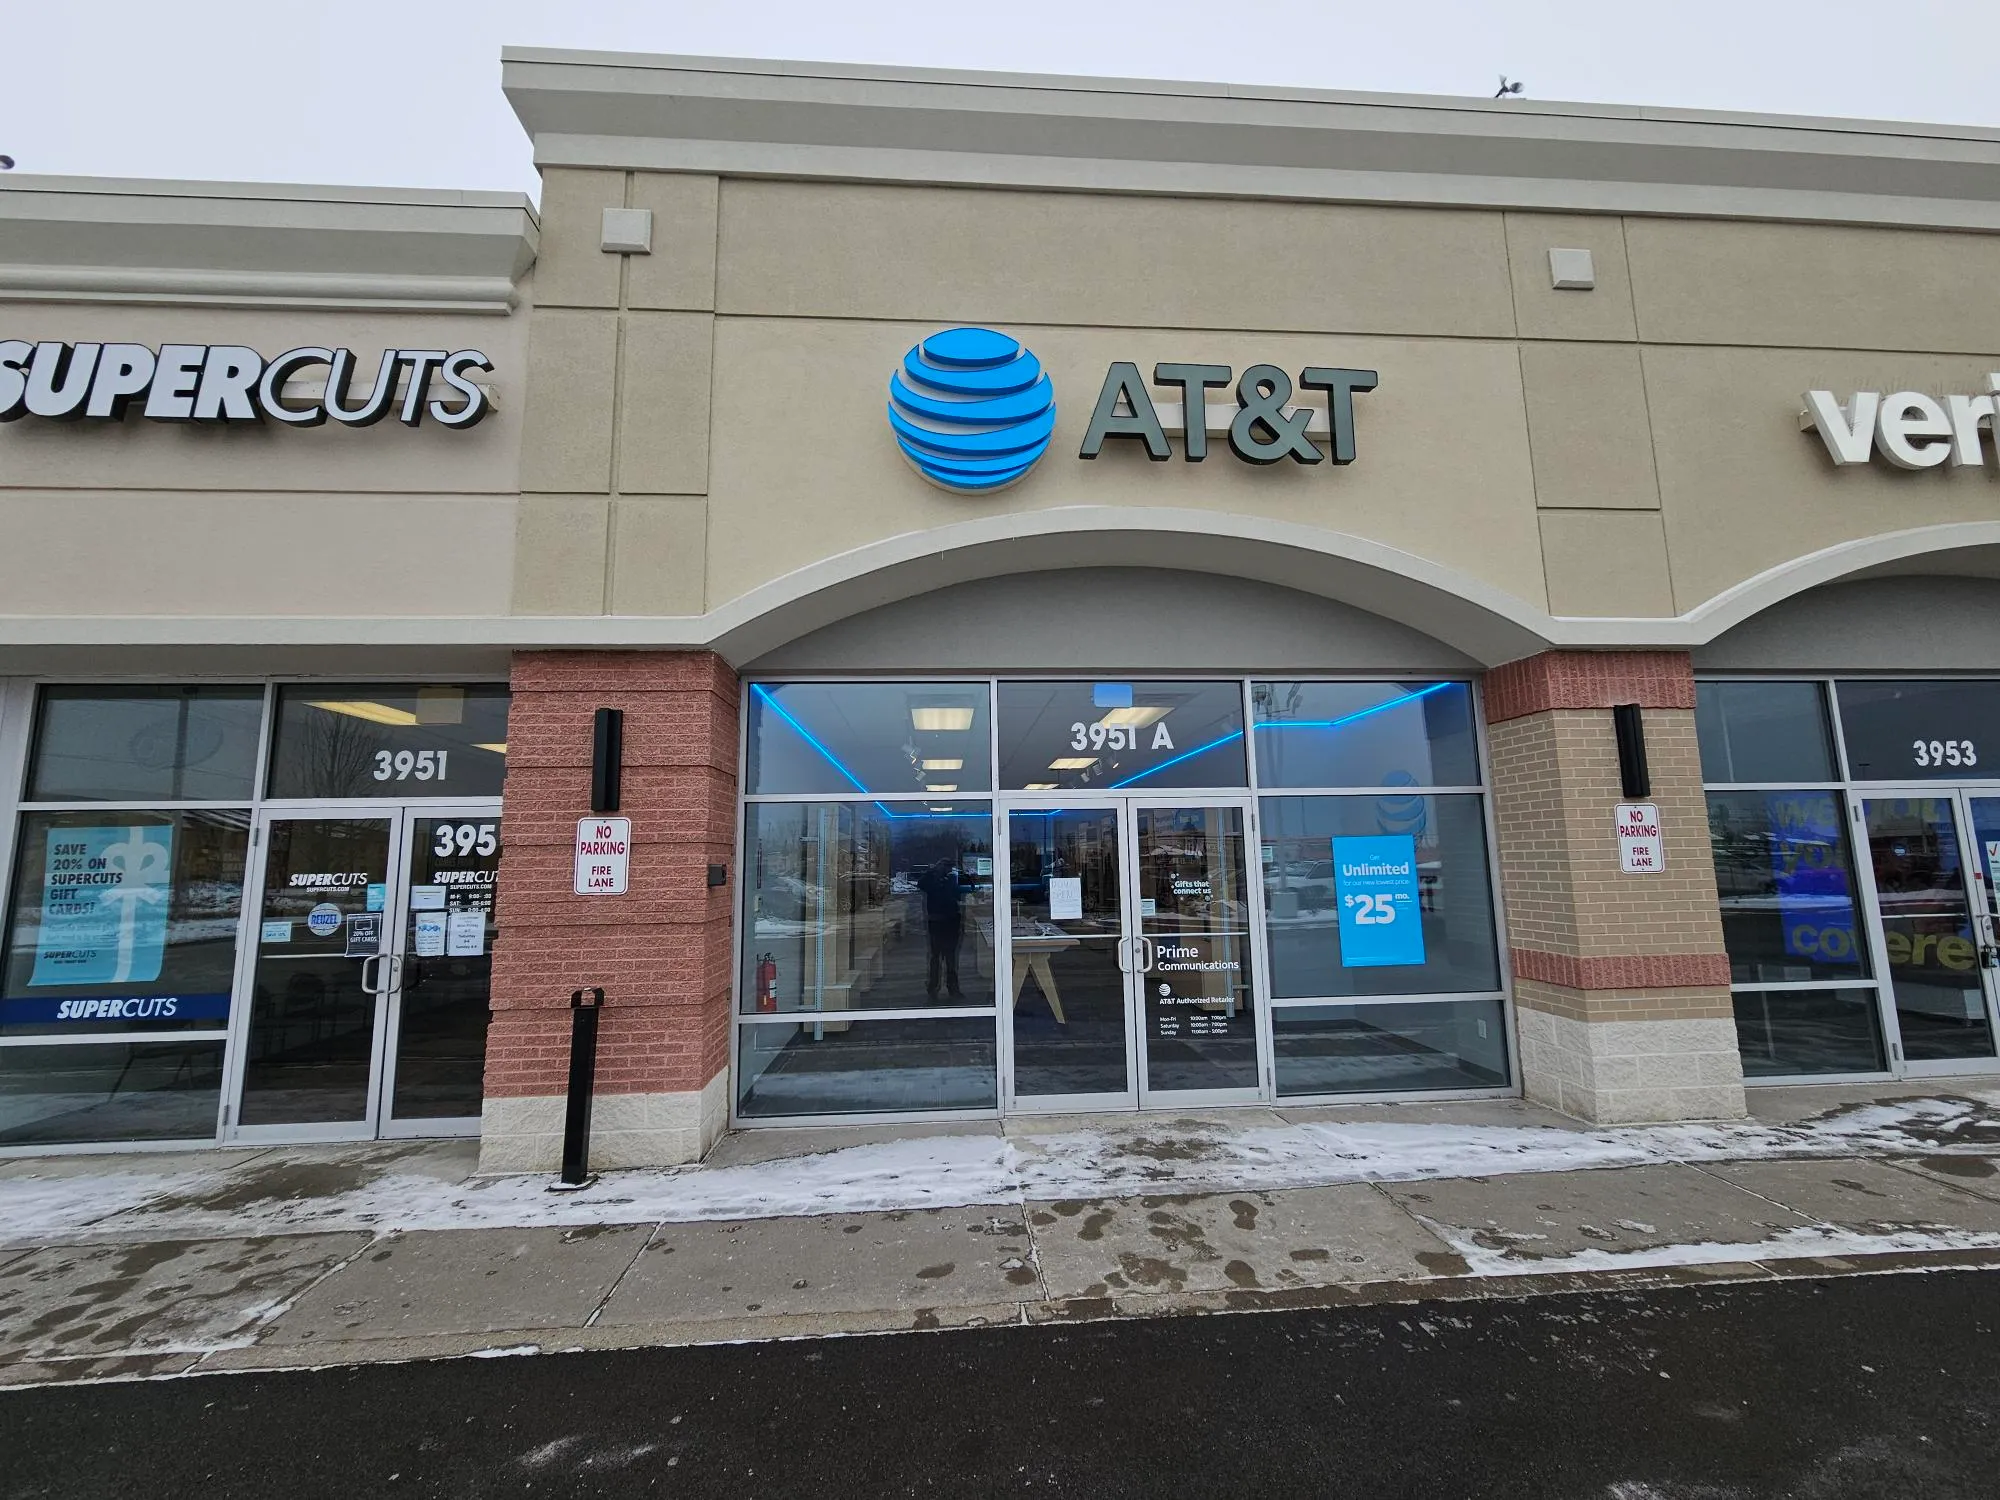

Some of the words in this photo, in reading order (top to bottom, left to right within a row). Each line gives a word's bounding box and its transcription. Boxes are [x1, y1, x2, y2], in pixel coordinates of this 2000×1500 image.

[0, 340, 495, 428] SUPERCUTS
[1079, 361, 1379, 466] AT&T
[1071, 722, 1137, 751] 3951
[1151, 722, 1175, 750] A
[1913, 740, 1977, 766] 3953
[373, 750, 448, 781] 3951
[1630, 810, 1644, 822] NO
[596, 825, 612, 839] NO
[1619, 825, 1657, 837] PARKING
[53, 844, 87, 855] SAVE
[580, 842, 625, 856] PARKING
[1632, 846, 1649, 856] FIRE
[53, 859, 83, 870] 20%
[87, 858, 107, 869] ON
[1342, 861, 1409, 876] Unlimited
[1631, 858, 1653, 867] LANE
[591, 866, 612, 876] FIRE
[51, 873, 123, 886] SUPERCUTS
[289, 872, 368, 886] SUPERCUTS
[588, 878, 614, 888] LANE
[1174, 880, 1193, 888] Gifts
[1193, 880, 1210, 888] that
[50, 888, 79, 900] GIFT
[1173, 887, 1202, 895] connect
[48, 902, 96, 915] CARDS!
[1344, 893, 1396, 925] $25
[310, 913, 338, 925] REUZEL
[43, 949, 97, 959] SUPERCUTS
[1156, 944, 1199, 959] Prime
[1157, 960, 1240, 971] Communications
[1176, 997, 1211, 1005] Authorized
[1210, 996, 1235, 1004] Retailer
[57, 997, 178, 1019] SUPERCUTS
